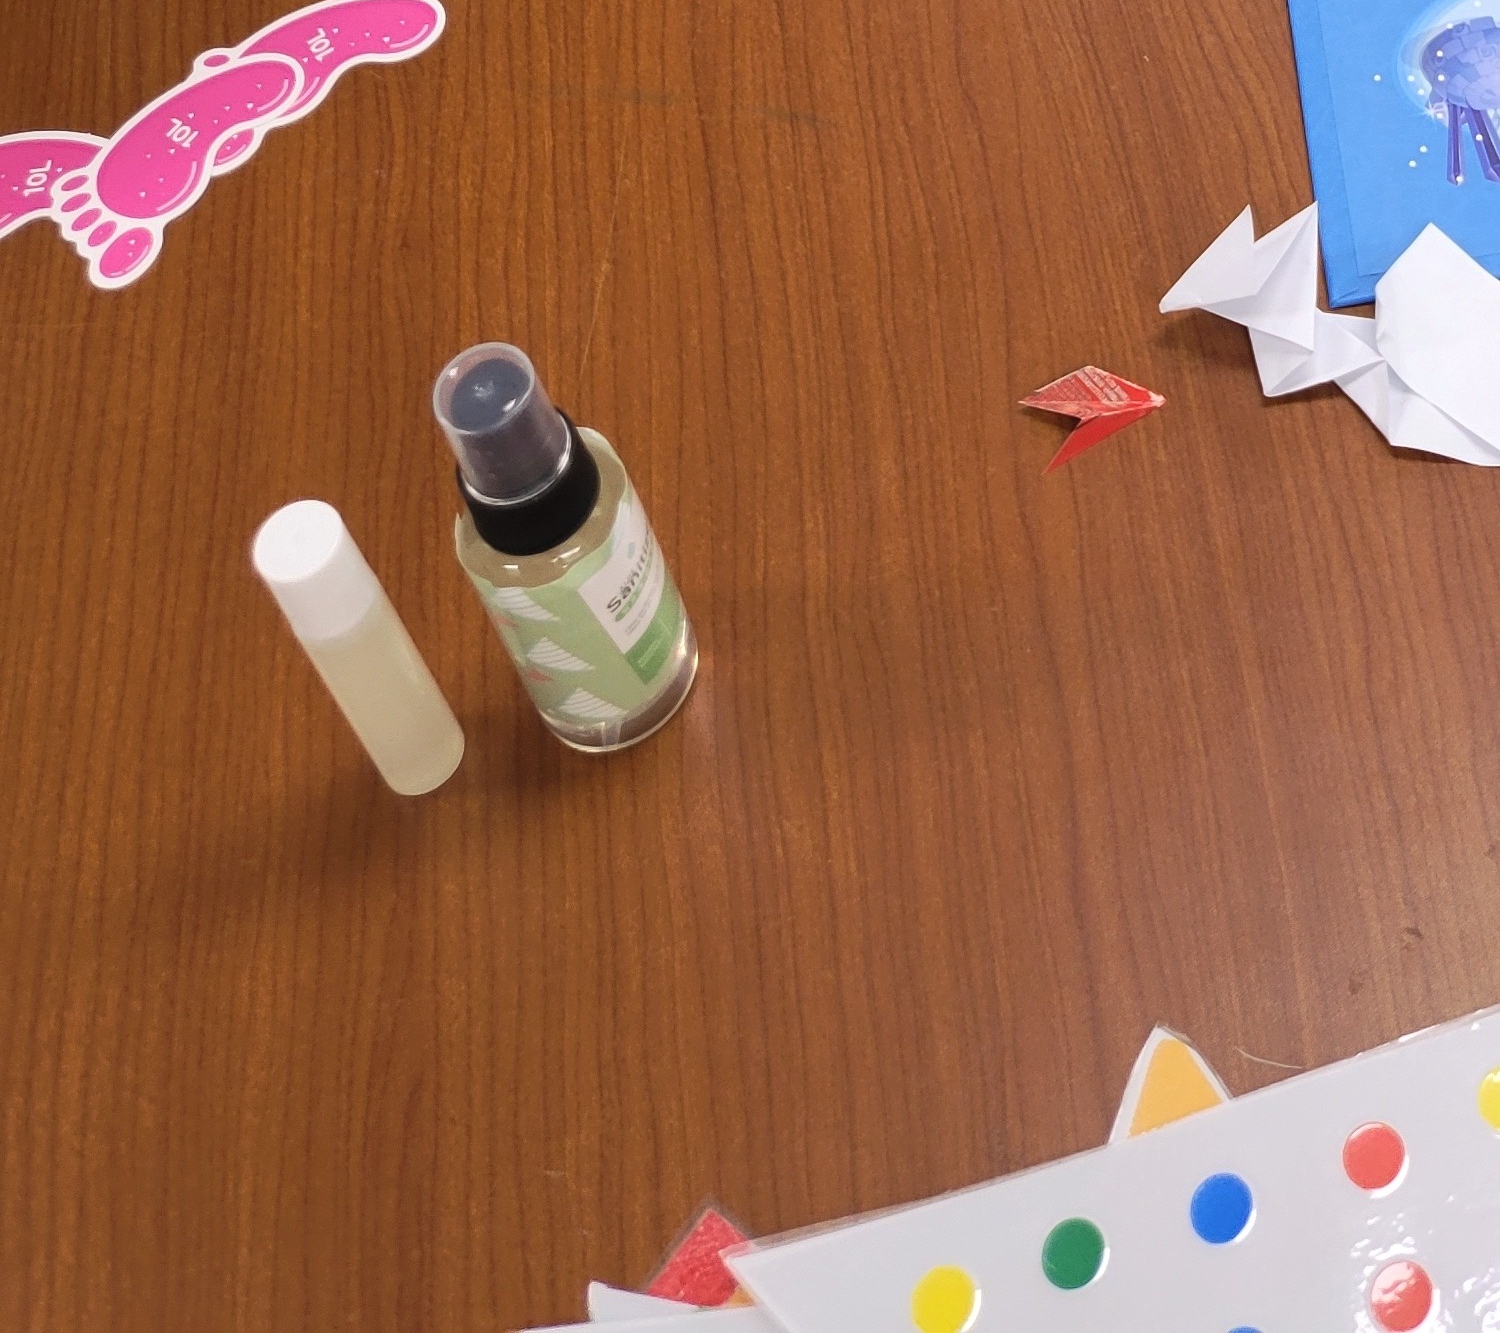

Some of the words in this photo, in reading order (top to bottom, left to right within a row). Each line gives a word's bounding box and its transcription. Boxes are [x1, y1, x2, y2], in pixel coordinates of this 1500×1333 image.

[305, 27, 334, 59] 10L
[167, 117, 200, 147] 10L
[22, 159, 51, 198] 10L
